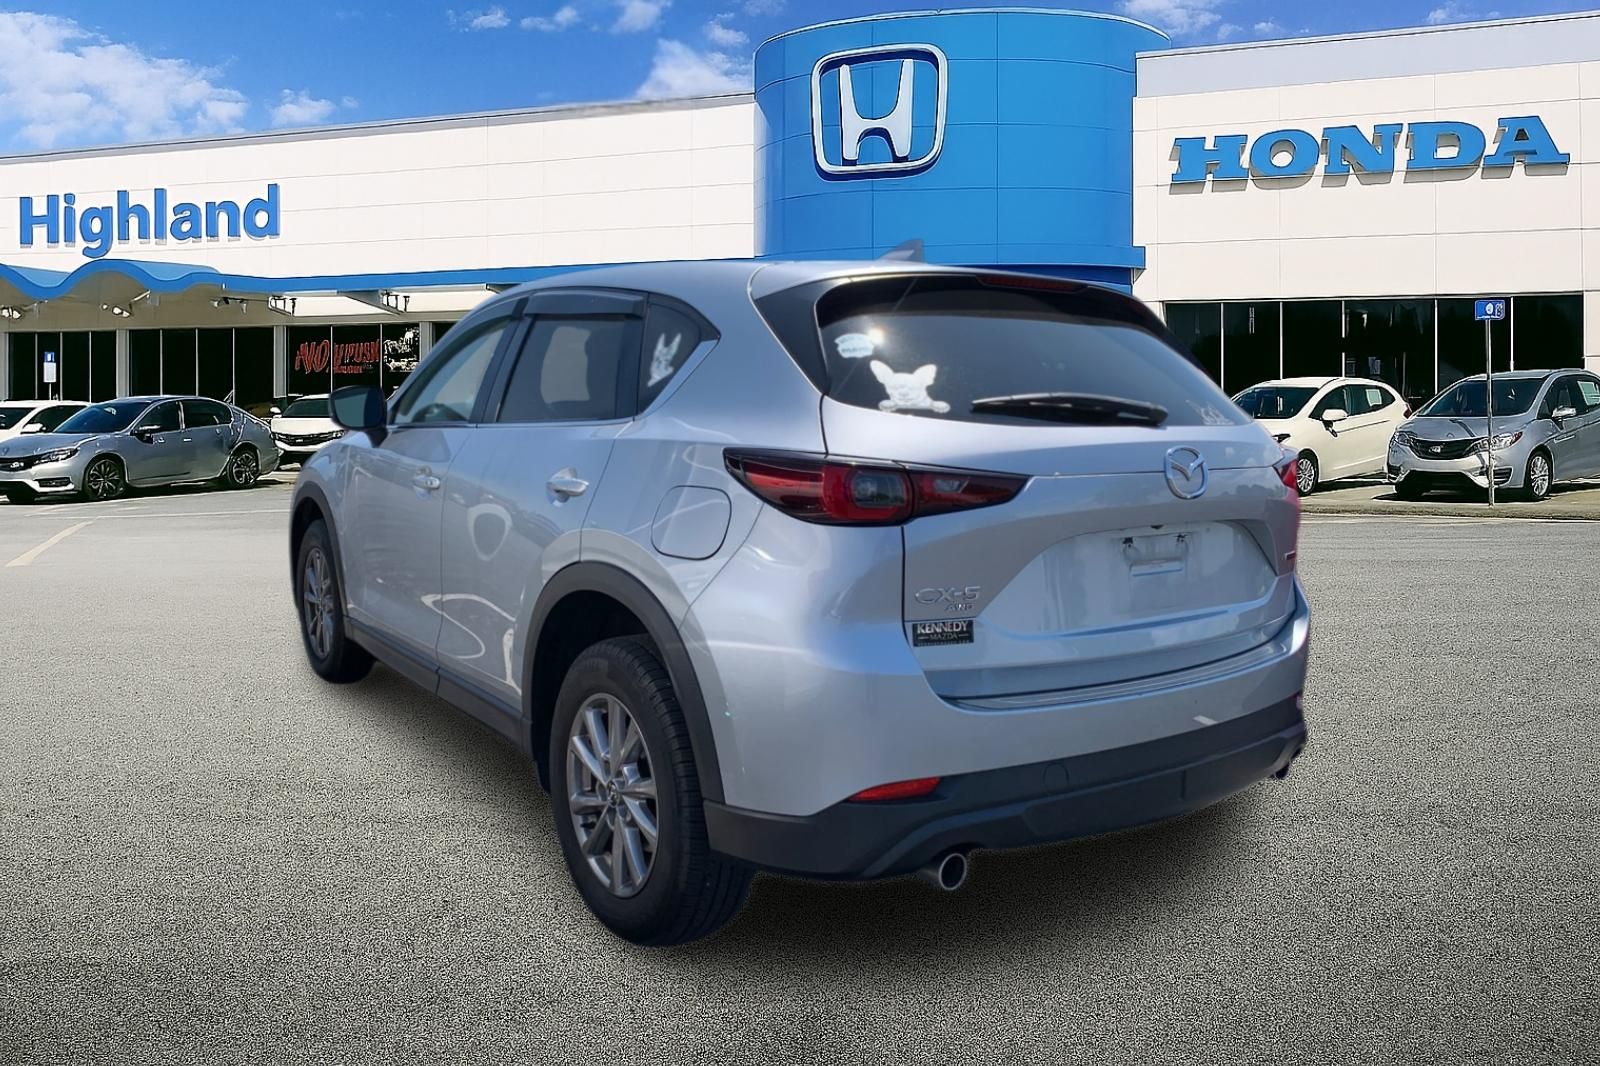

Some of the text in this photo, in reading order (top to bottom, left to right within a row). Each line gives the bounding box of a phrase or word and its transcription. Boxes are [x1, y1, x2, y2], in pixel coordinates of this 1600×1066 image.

[1171, 115, 1571, 187] HONDA
[19, 183, 281, 258] Highland
[915, 586, 981, 604] CX-5
[917, 621, 968, 633] KENNEDY
